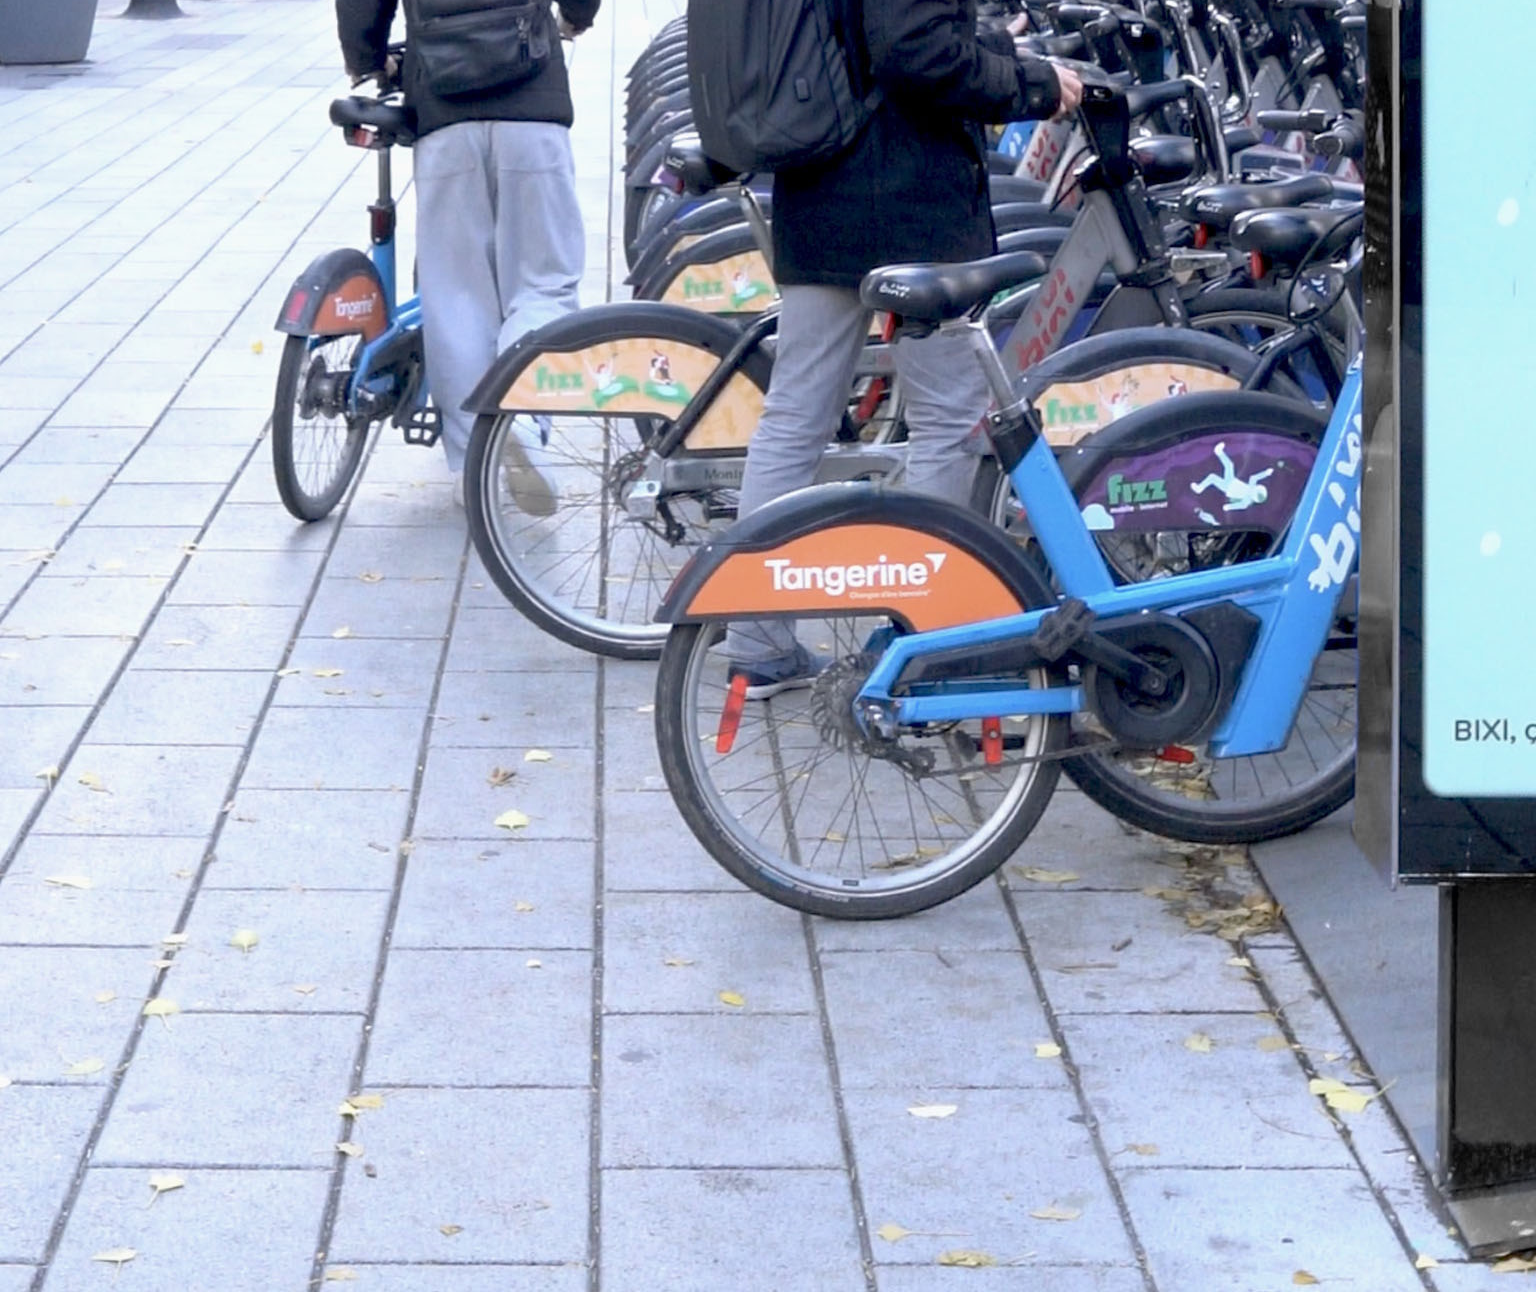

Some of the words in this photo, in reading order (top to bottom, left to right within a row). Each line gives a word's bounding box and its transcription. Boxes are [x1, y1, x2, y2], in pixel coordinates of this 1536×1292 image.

[1107, 473, 1168, 506] fizz
[765, 555, 928, 596] Tangerine
[1454, 718, 1517, 745] BIXI,
